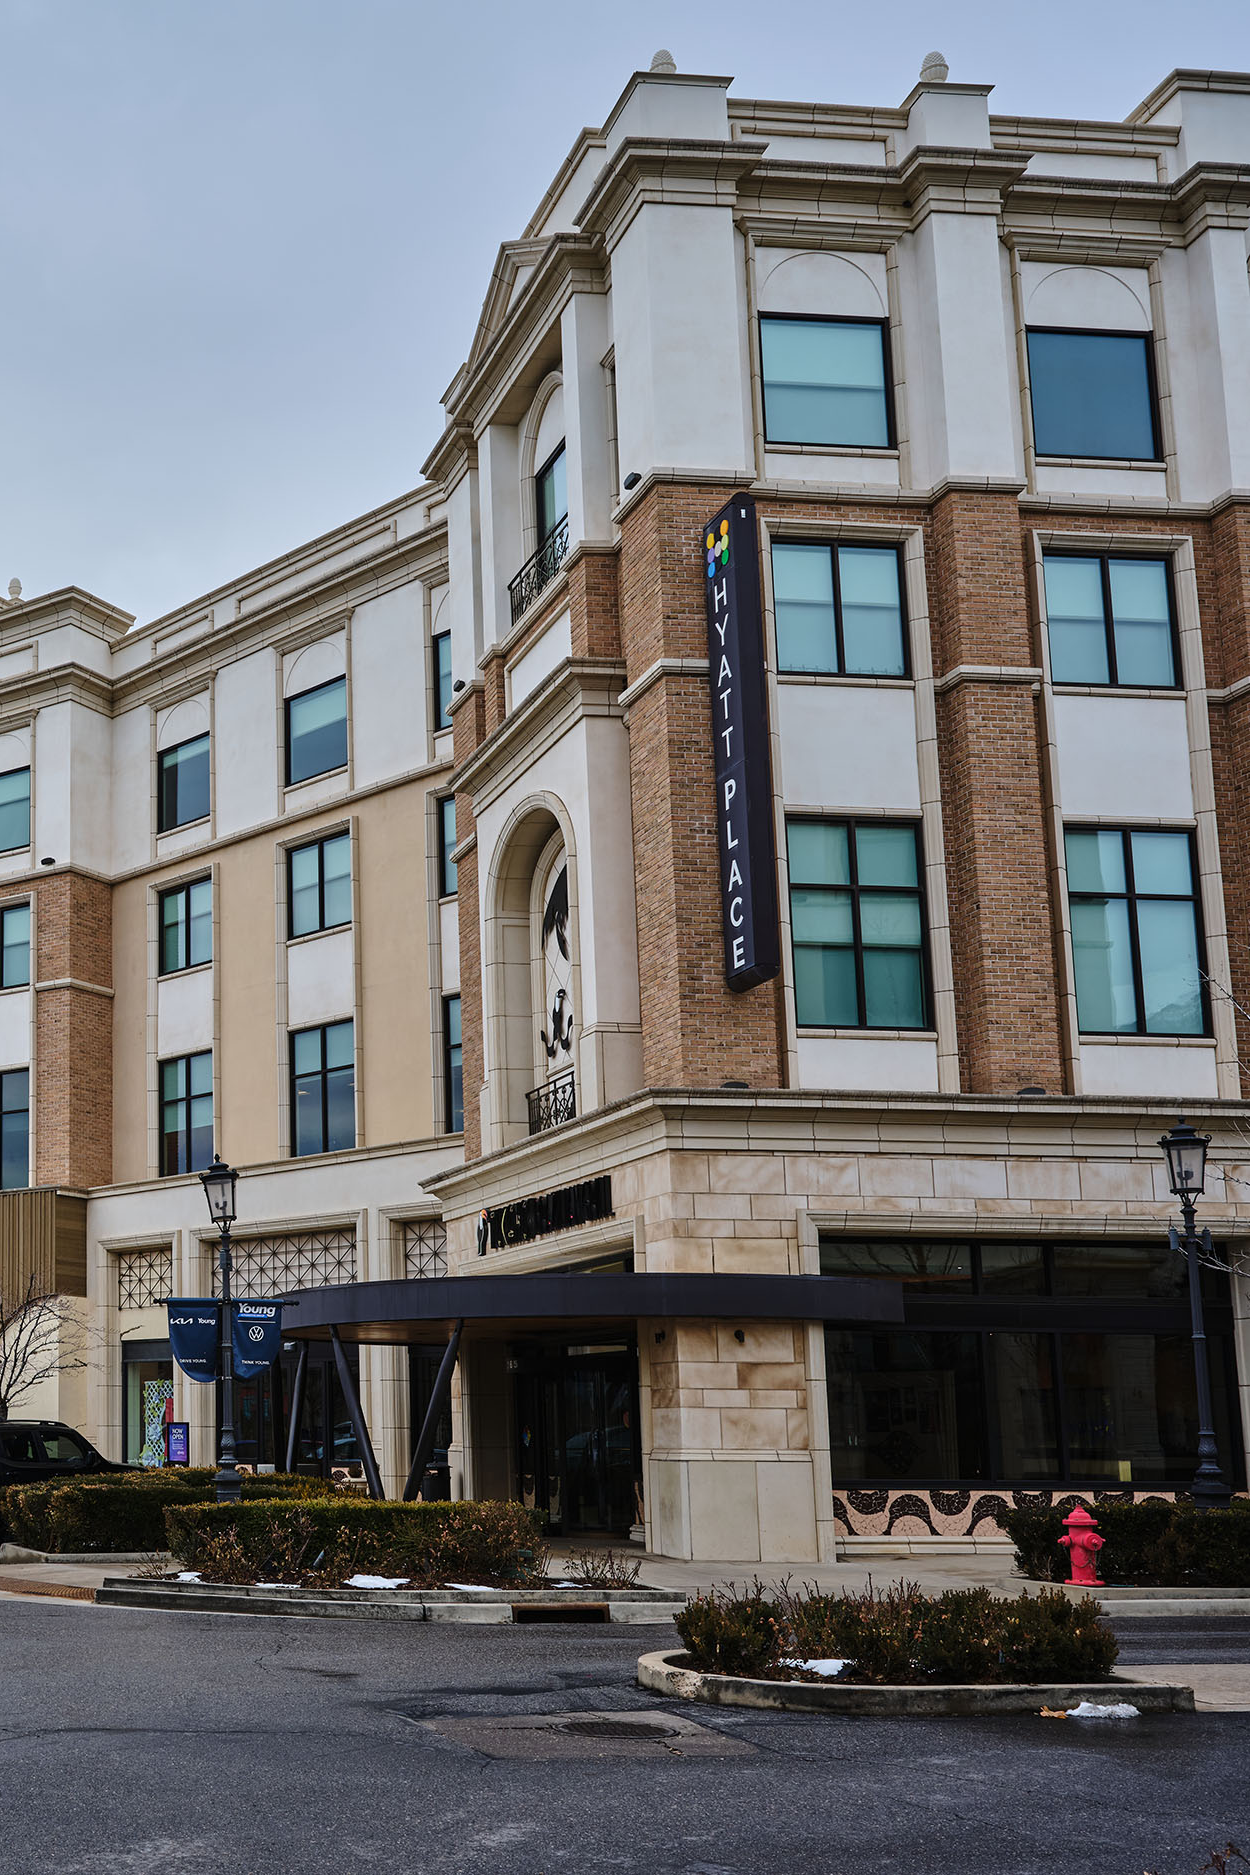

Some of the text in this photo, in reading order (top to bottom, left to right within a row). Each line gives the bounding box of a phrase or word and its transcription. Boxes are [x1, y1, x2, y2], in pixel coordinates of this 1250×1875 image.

[714, 577, 746, 969] HYATT PLACE
[238, 1303, 276, 1317] Young
[197, 1317, 216, 1325] Young
